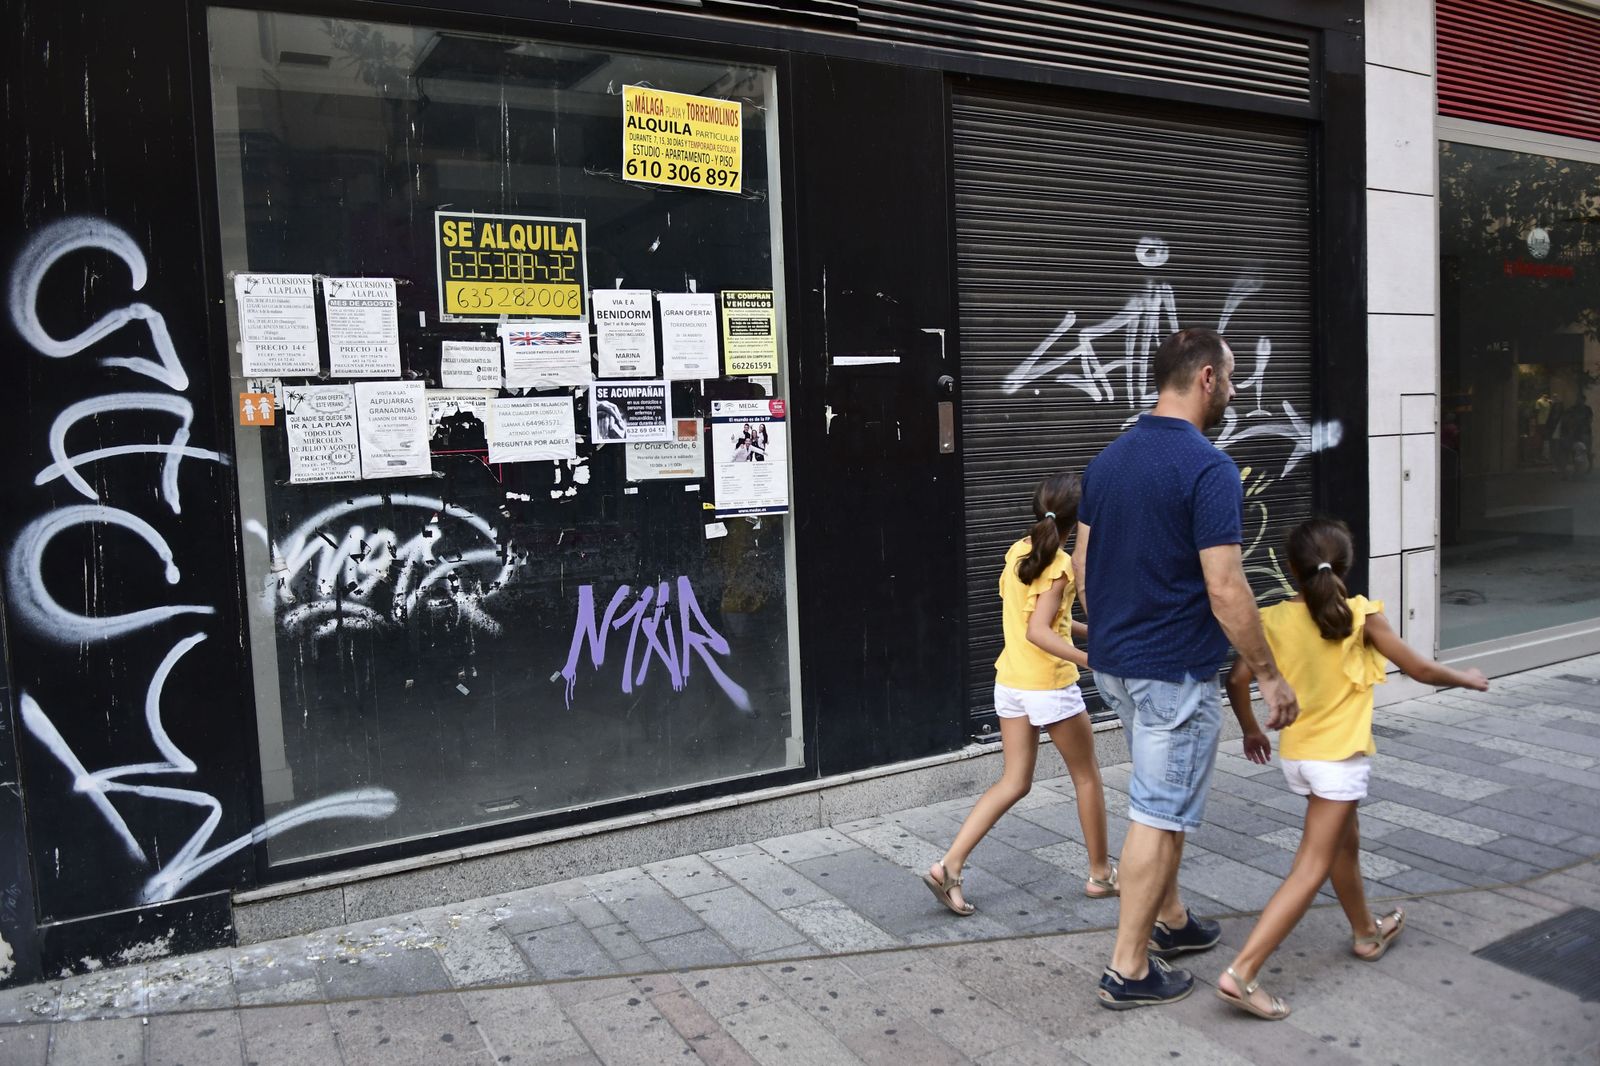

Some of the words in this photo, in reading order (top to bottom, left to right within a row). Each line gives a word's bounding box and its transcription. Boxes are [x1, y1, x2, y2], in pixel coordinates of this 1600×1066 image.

[626, 100, 634, 112] EN
[634, 92, 664, 116] MÁLAGA
[666, 106, 682, 118] PLAYA
[682, 108, 686, 116] Y
[686, 102, 739, 127] TORREMOLINOS
[627, 116, 692, 136] ALQUILA
[696, 130, 739, 142] PARTICULAR
[629, 133, 652, 143] DURANTE
[688, 141, 716, 152] TEMPORADA
[716, 144, 736, 154] ESCOLAR
[633, 144, 660, 158] ESTUDIO
[665, 148, 710, 164] APARTAMENTO
[714, 155, 718, 166] Y
[720, 156, 733, 168] PISO
[626, 158, 662, 178] 610
[667, 163, 700, 183] 306
[706, 168, 739, 188] 897
[442, 220, 473, 248] SE
[480, 223, 578, 252] ALQUILA
[449, 250, 576, 282] 635388432
[262, 277, 312, 286] EXCURSIONES
[346, 281, 392, 289] EXCURSIONES
[458, 288, 578, 310] 635282008
[596, 310, 651, 319] BENIDORM
[597, 388, 608, 398] SE
[610, 385, 664, 398] ACOMPAÑAN
[492, 440, 532, 448] PREGUNTAR
[664, 442, 690, 450] Conde,
